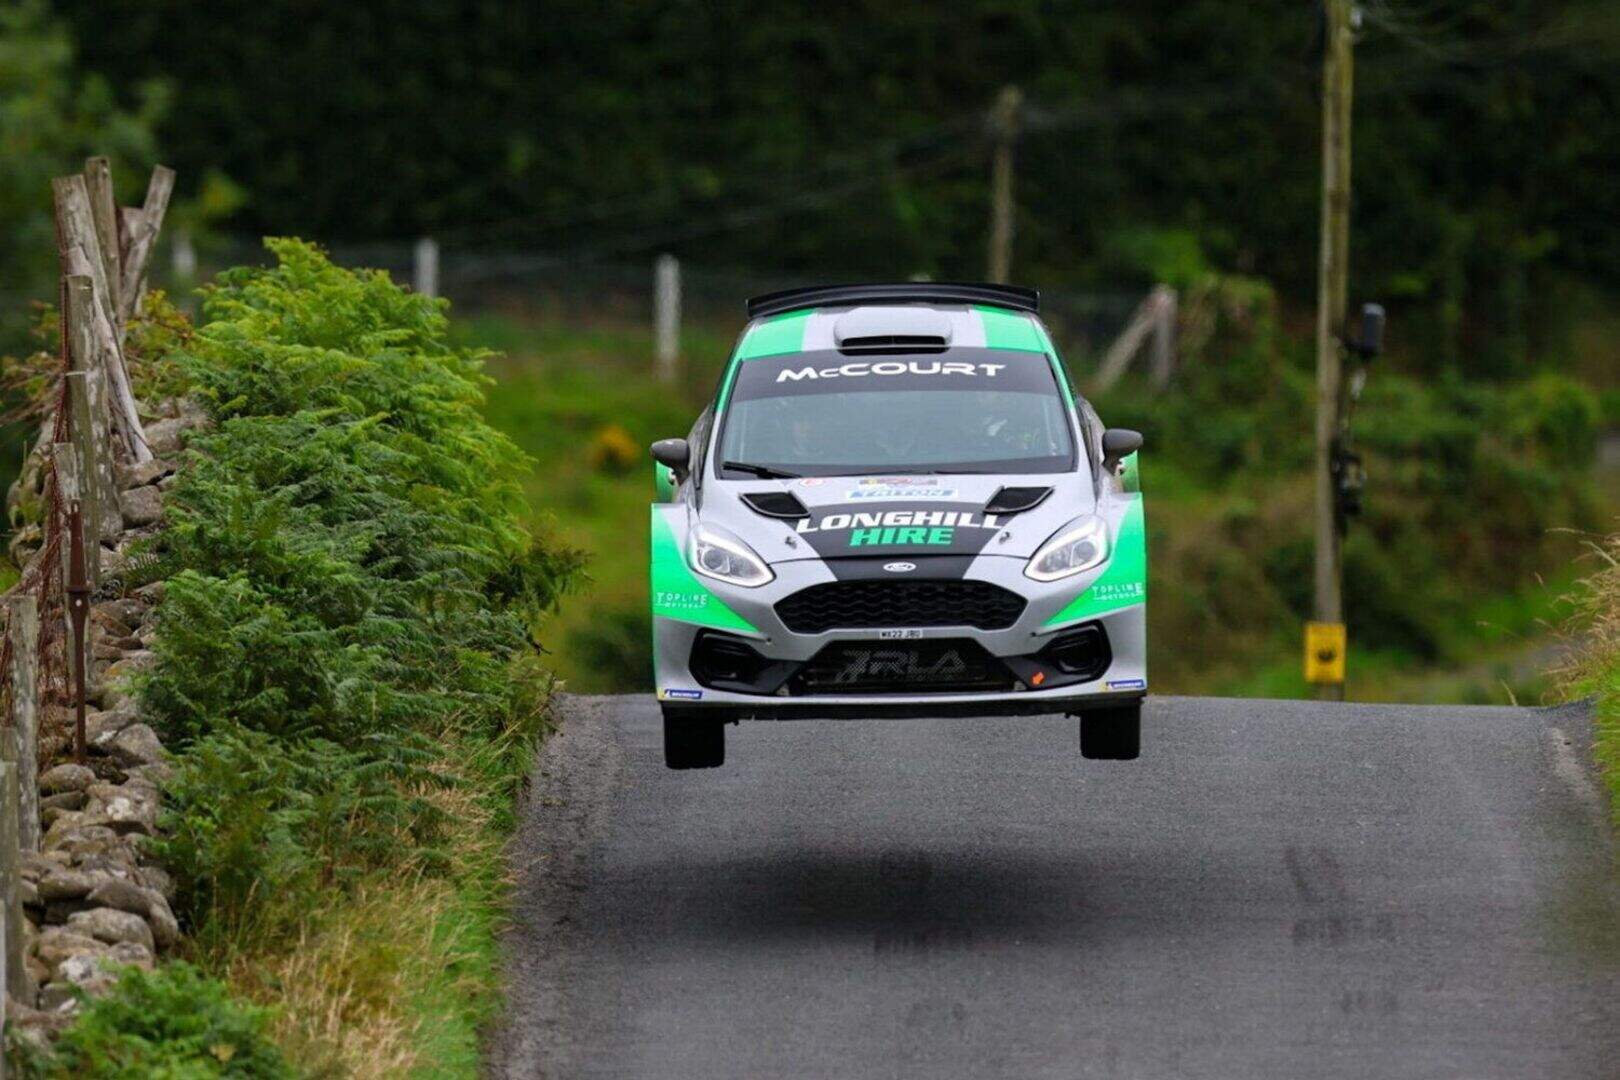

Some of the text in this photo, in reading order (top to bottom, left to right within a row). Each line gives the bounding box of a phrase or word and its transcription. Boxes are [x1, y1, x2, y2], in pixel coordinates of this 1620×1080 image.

[776, 362, 1006, 383] McCOURT
[796, 510, 1004, 534] LONGHILL
[850, 527, 955, 547] HIRE
